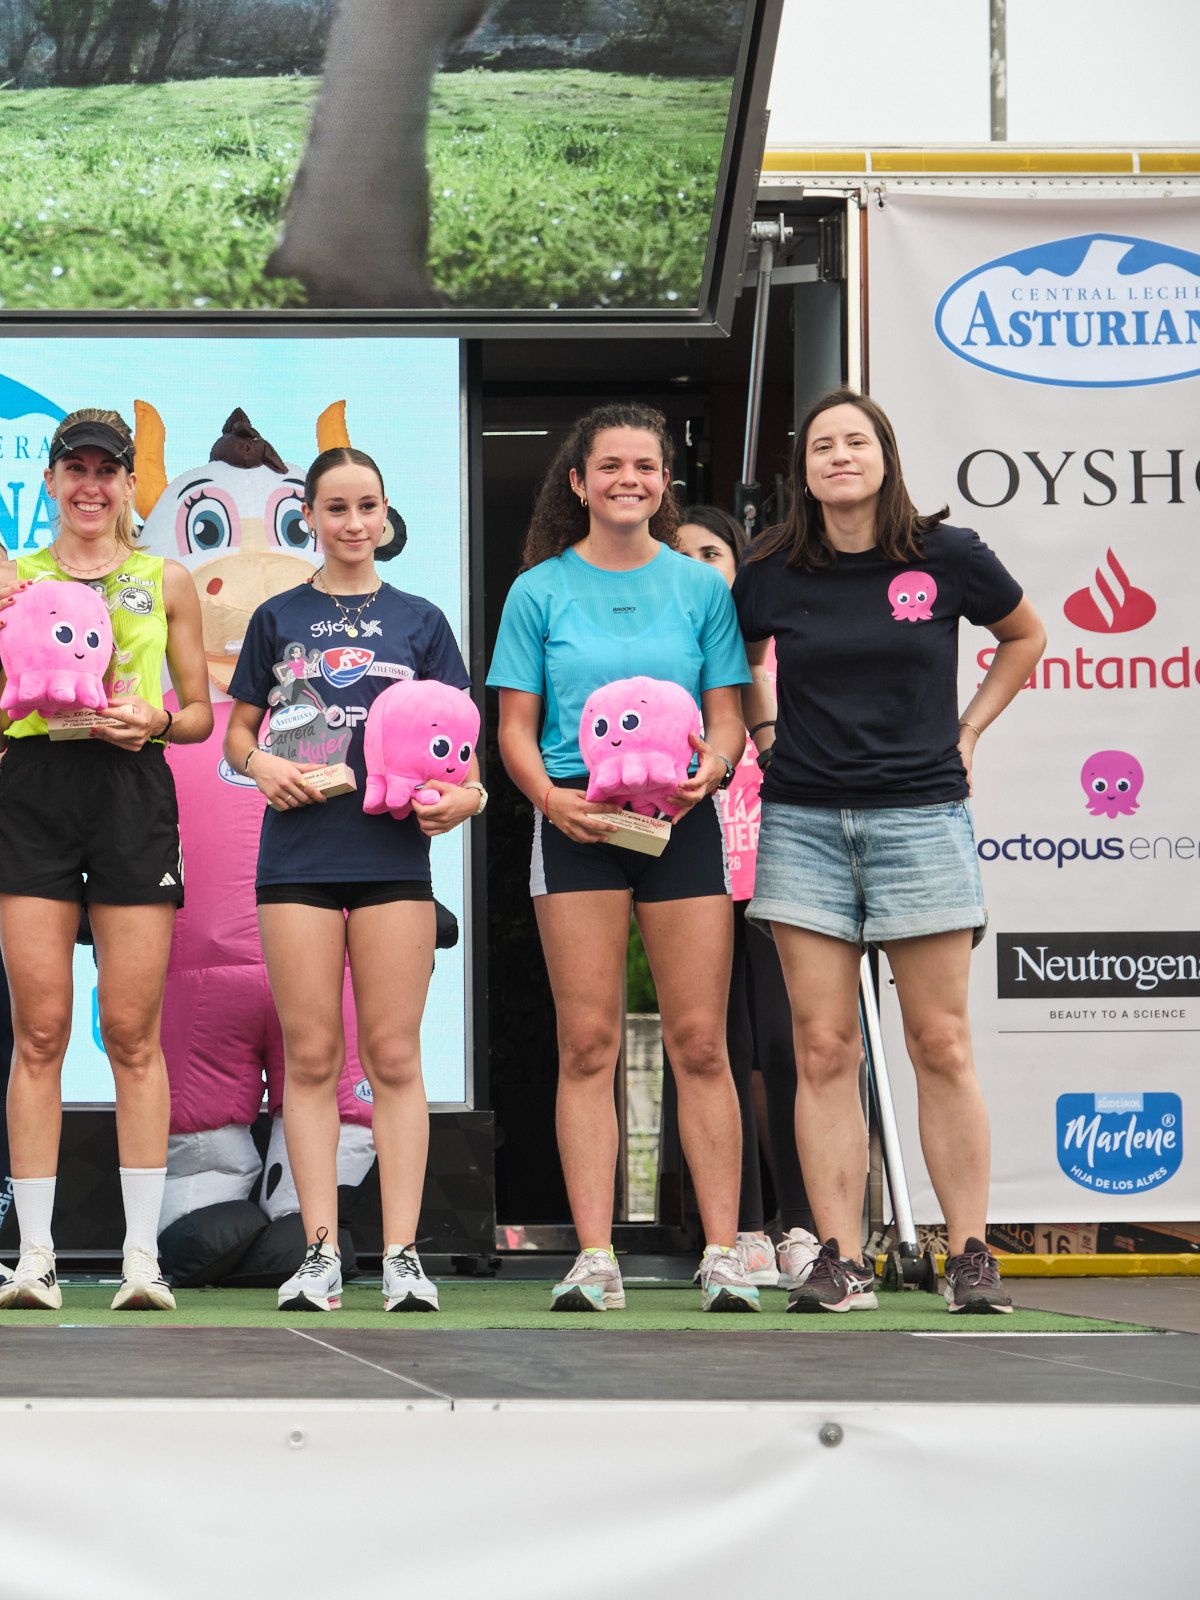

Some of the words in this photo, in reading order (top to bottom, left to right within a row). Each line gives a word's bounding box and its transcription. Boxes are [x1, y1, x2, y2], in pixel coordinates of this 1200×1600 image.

[1012, 287, 1115, 301] CENTRAL
[957, 448, 1200, 507] OYSH
[370, 665, 410, 678] ATLETISMO
[275, 711, 313, 728] ASTURIANA
[265, 725, 316, 748] Carrera
[297, 732, 347, 765] Mujer
[977, 834, 1125, 868] octopus
[1012, 946, 1200, 991] Neutrogen
[1049, 1010, 1097, 1019] BEAUTY
[1101, 1010, 1117, 1019] TO
[1121, 1010, 1129, 1019] A
[1133, 1009, 1187, 1019] SCIENCE
[1064, 1113, 1176, 1168] Marlene
[1070, 1165, 1093, 1185] HIJA
[1095, 1178, 1110, 1189] DE
[1112, 1180, 1134, 1190] LOS
[1136, 1166, 1168, 1188] ALPES
[1042, 1230, 1071, 1254] 16
